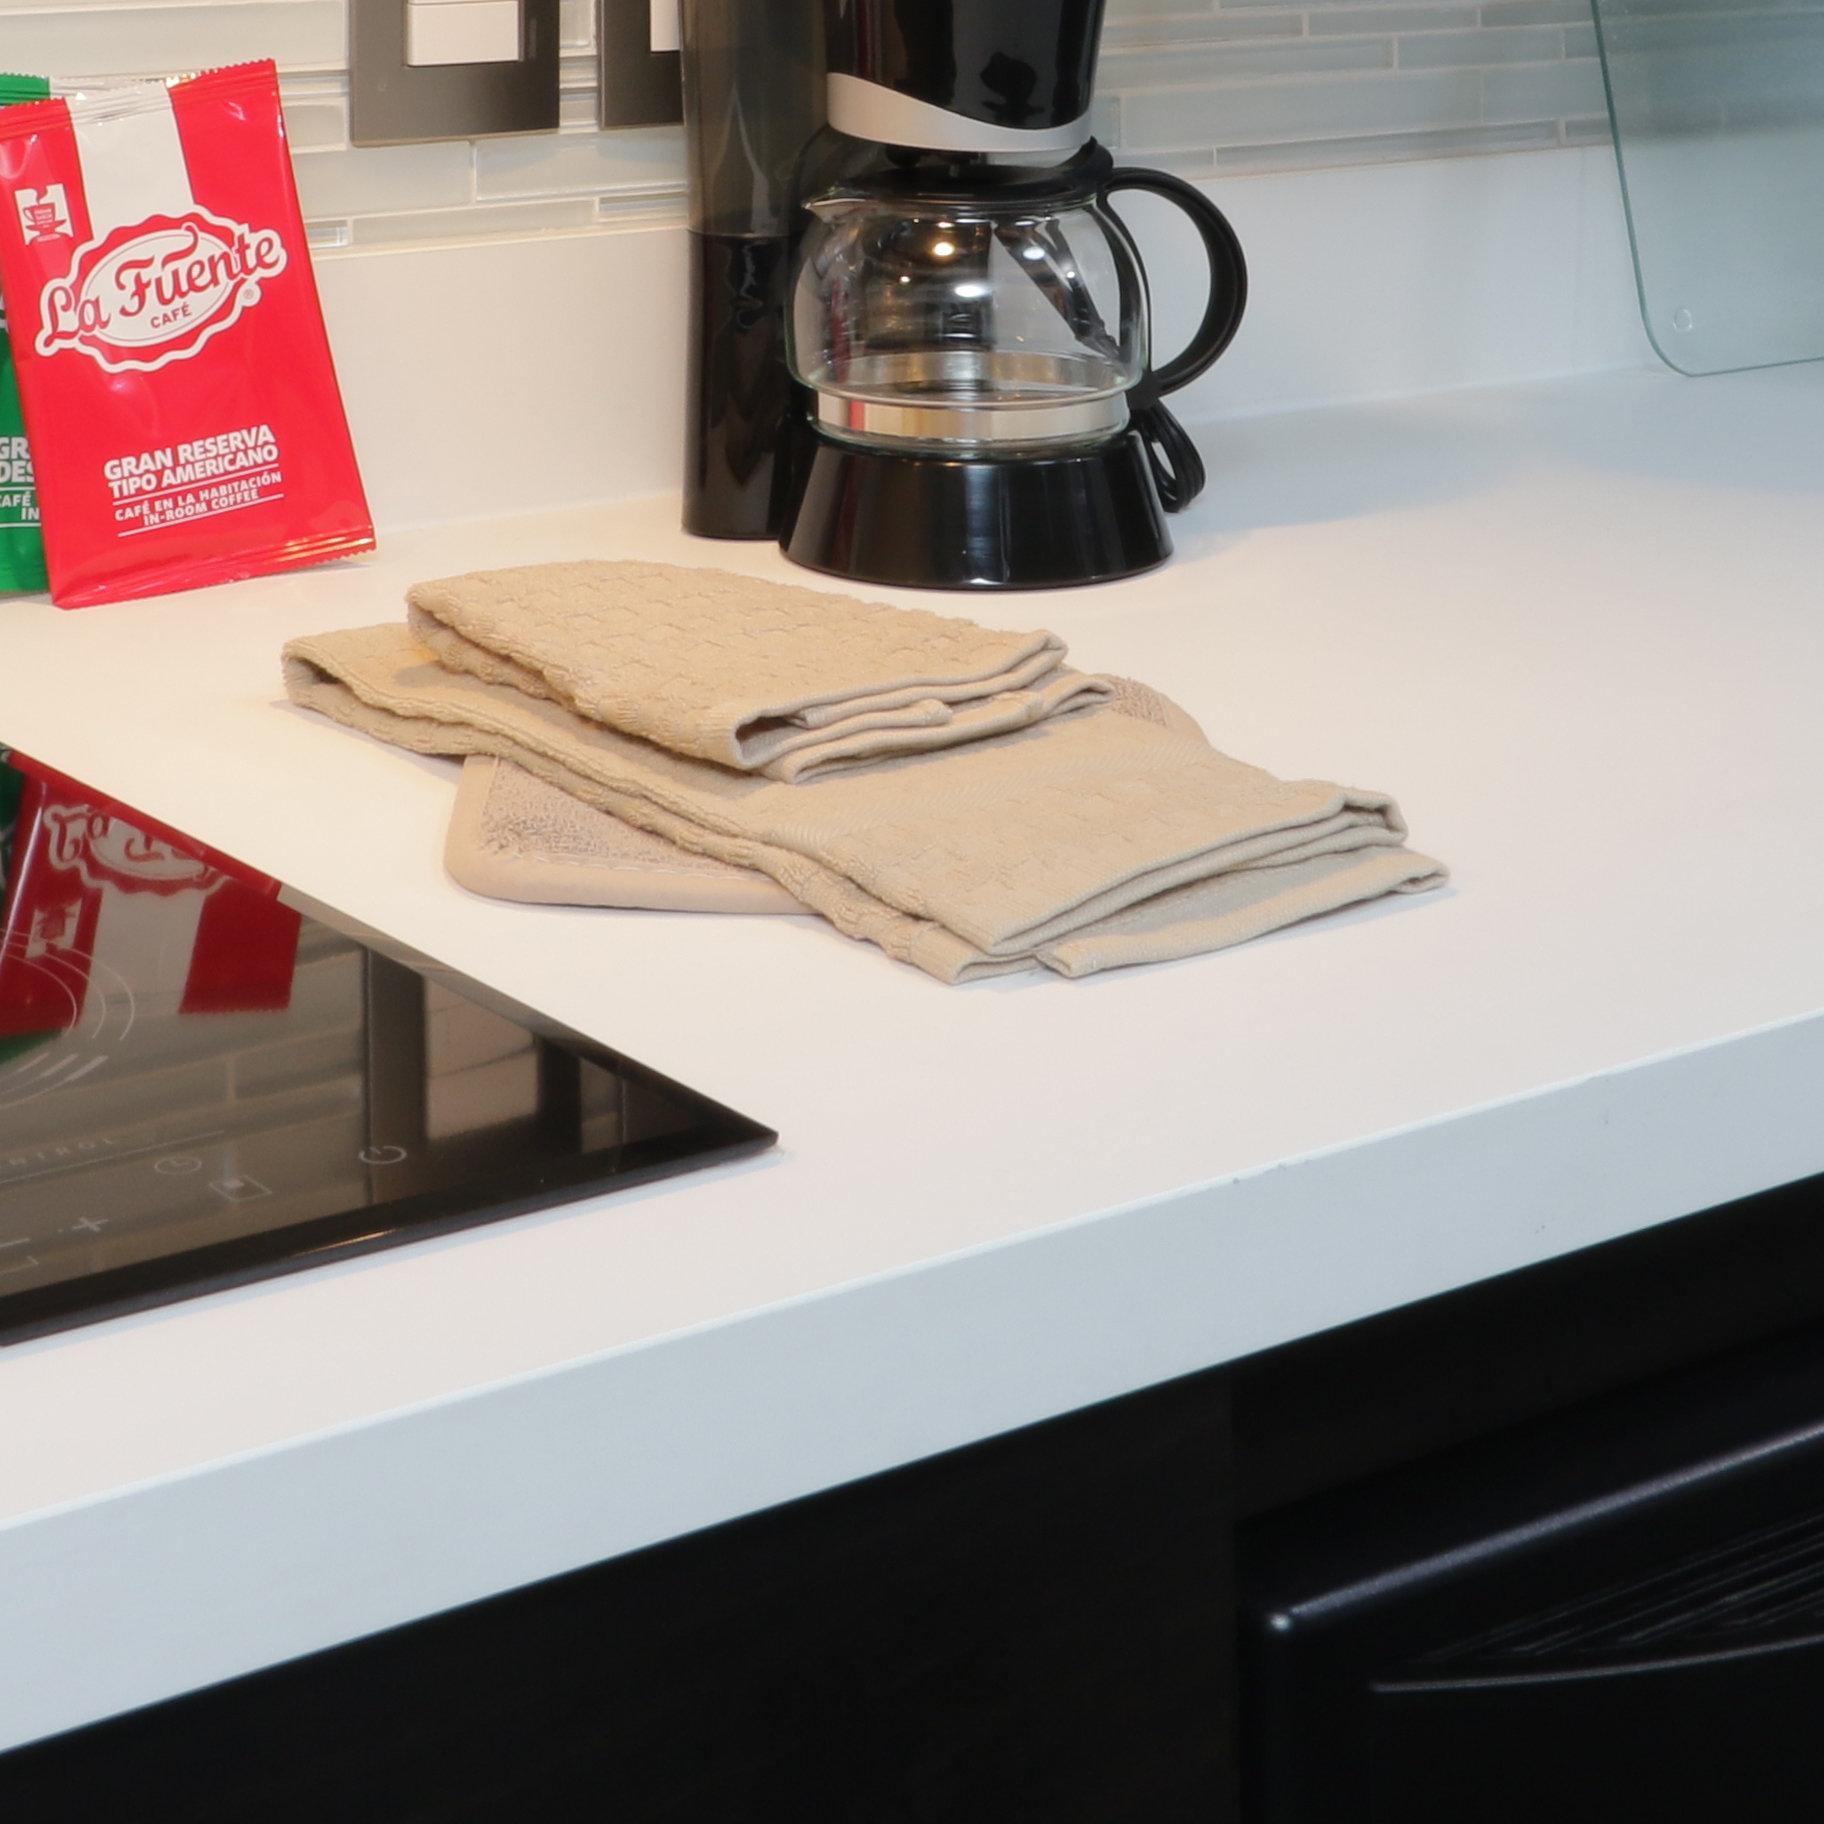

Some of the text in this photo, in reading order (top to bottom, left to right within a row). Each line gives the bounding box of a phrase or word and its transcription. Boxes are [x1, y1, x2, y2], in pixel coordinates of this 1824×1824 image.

[43, 284, 111, 348] La
[114, 221, 280, 317] Fuente
[149, 302, 193, 329] CAFÉ
[103, 424, 276, 481] GRAN RESERVA
[108, 444, 279, 499] TIPO AMERICANO
[114, 471, 282, 522] CAFÉ EN LA HABITACIÓN
[143, 488, 259, 527] IN-ROOM COFFEE
